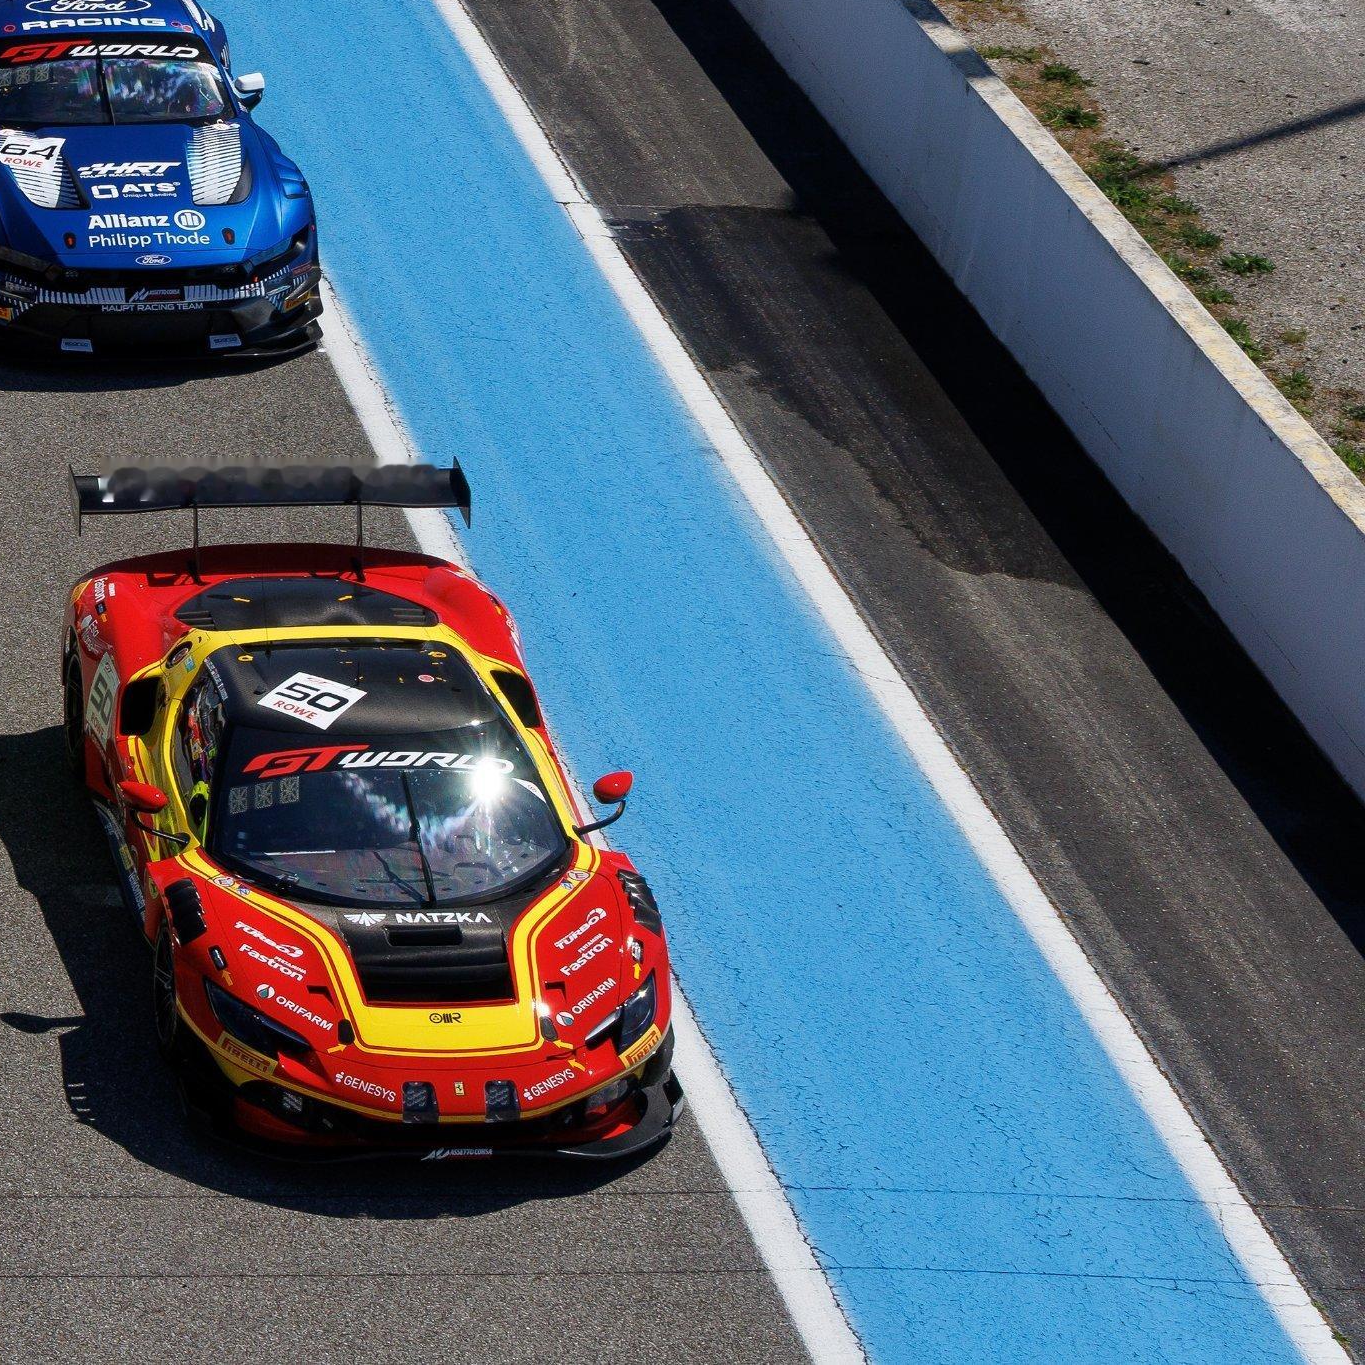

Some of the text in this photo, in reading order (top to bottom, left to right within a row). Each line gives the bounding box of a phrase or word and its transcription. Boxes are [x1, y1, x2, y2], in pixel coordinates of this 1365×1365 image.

[21, 17, 166, 31] RACING
[0, 143, 58, 162] 64
[4, 158, 43, 168] ROWE
[122, 183, 176, 192] ATS
[88, 214, 169, 229] Allianz
[89, 232, 210, 248] Philipp Thode
[142, 256, 164, 264] Ford
[102, 302, 203, 312] HAUPT RACING TEAM
[273, 682, 350, 712] 50
[273, 698, 319, 721] ROWE
[395, 912, 492, 925] NATZKA
[239, 944, 304, 981] Fastron
[560, 937, 613, 976] Fastron
[572, 977, 617, 1015] ORIFARM
[276, 995, 333, 1031] ORIFARM
[626, 1031, 660, 1066] PIRELLI
[344, 1075, 396, 1102] GENESYS
[530, 1069, 575, 1097] GENESYS
